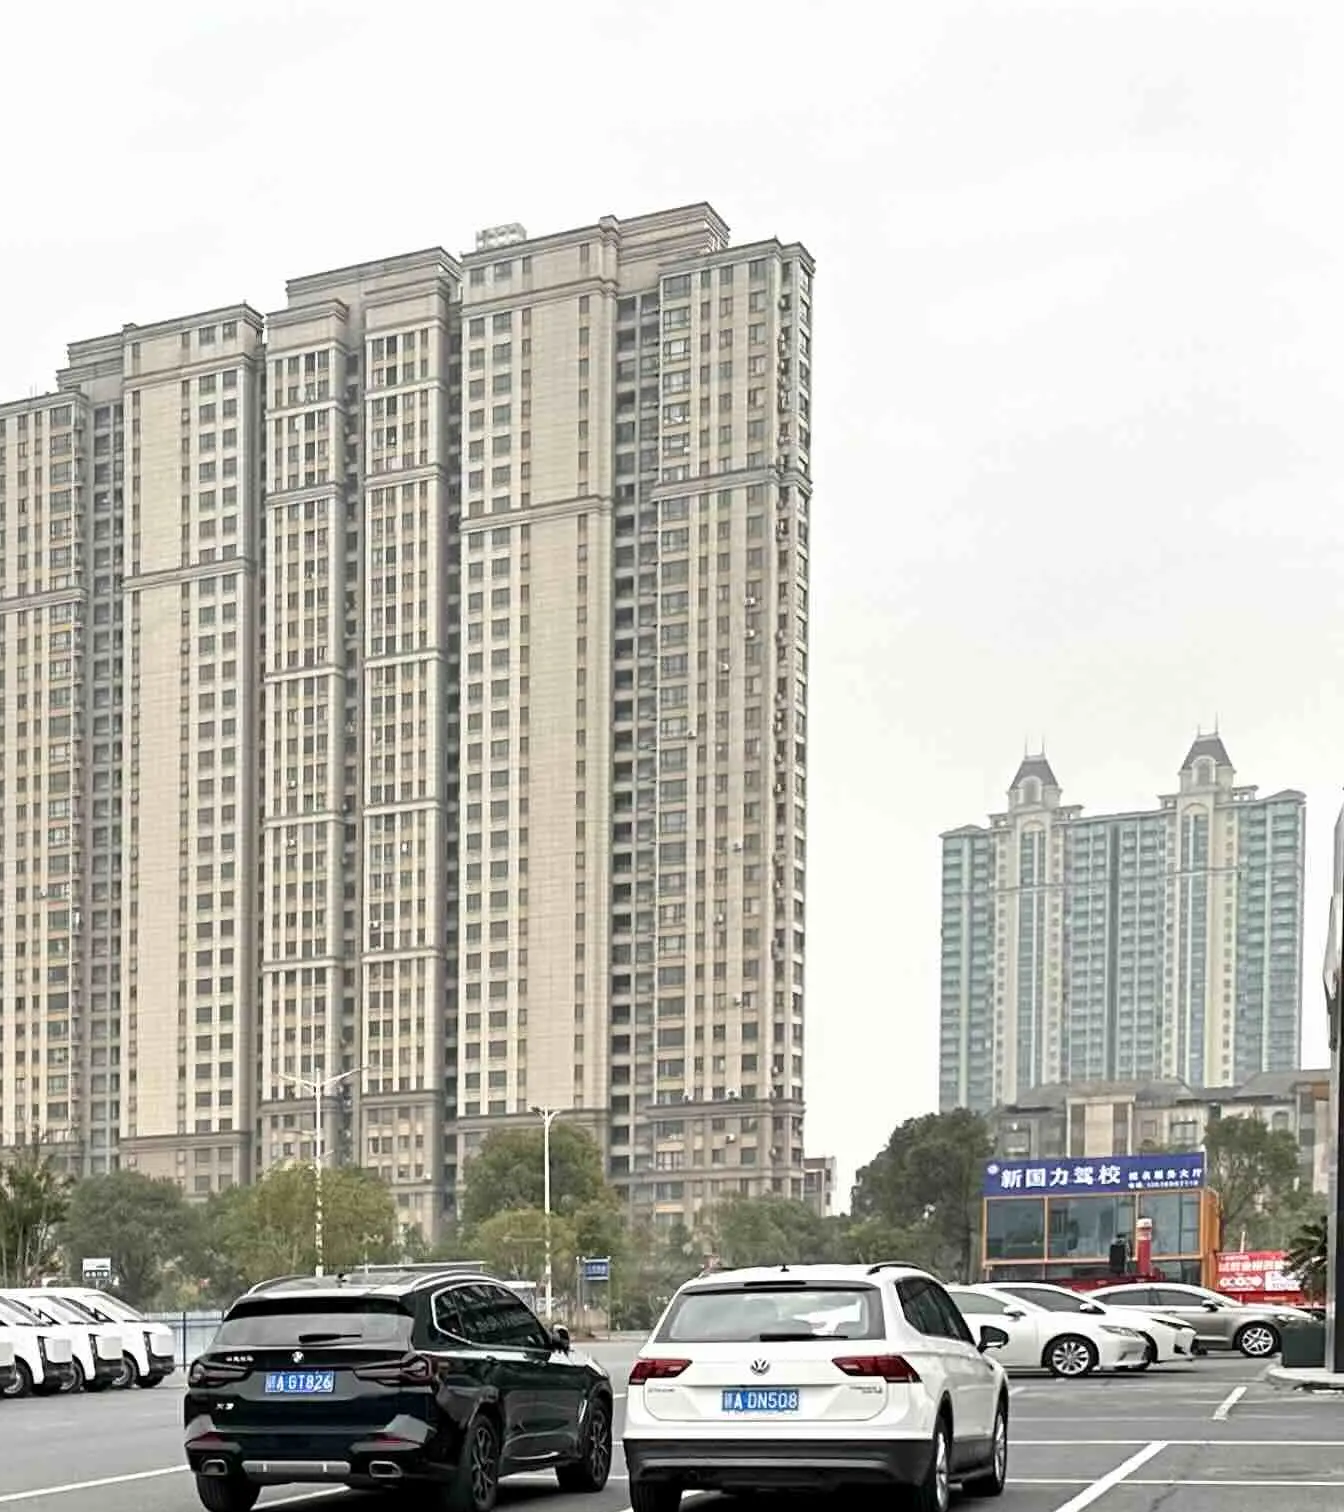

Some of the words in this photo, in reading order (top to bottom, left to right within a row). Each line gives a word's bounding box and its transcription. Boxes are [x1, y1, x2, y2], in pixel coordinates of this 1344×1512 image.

[1001, 1164, 1120, 1188] 新国力驾校
